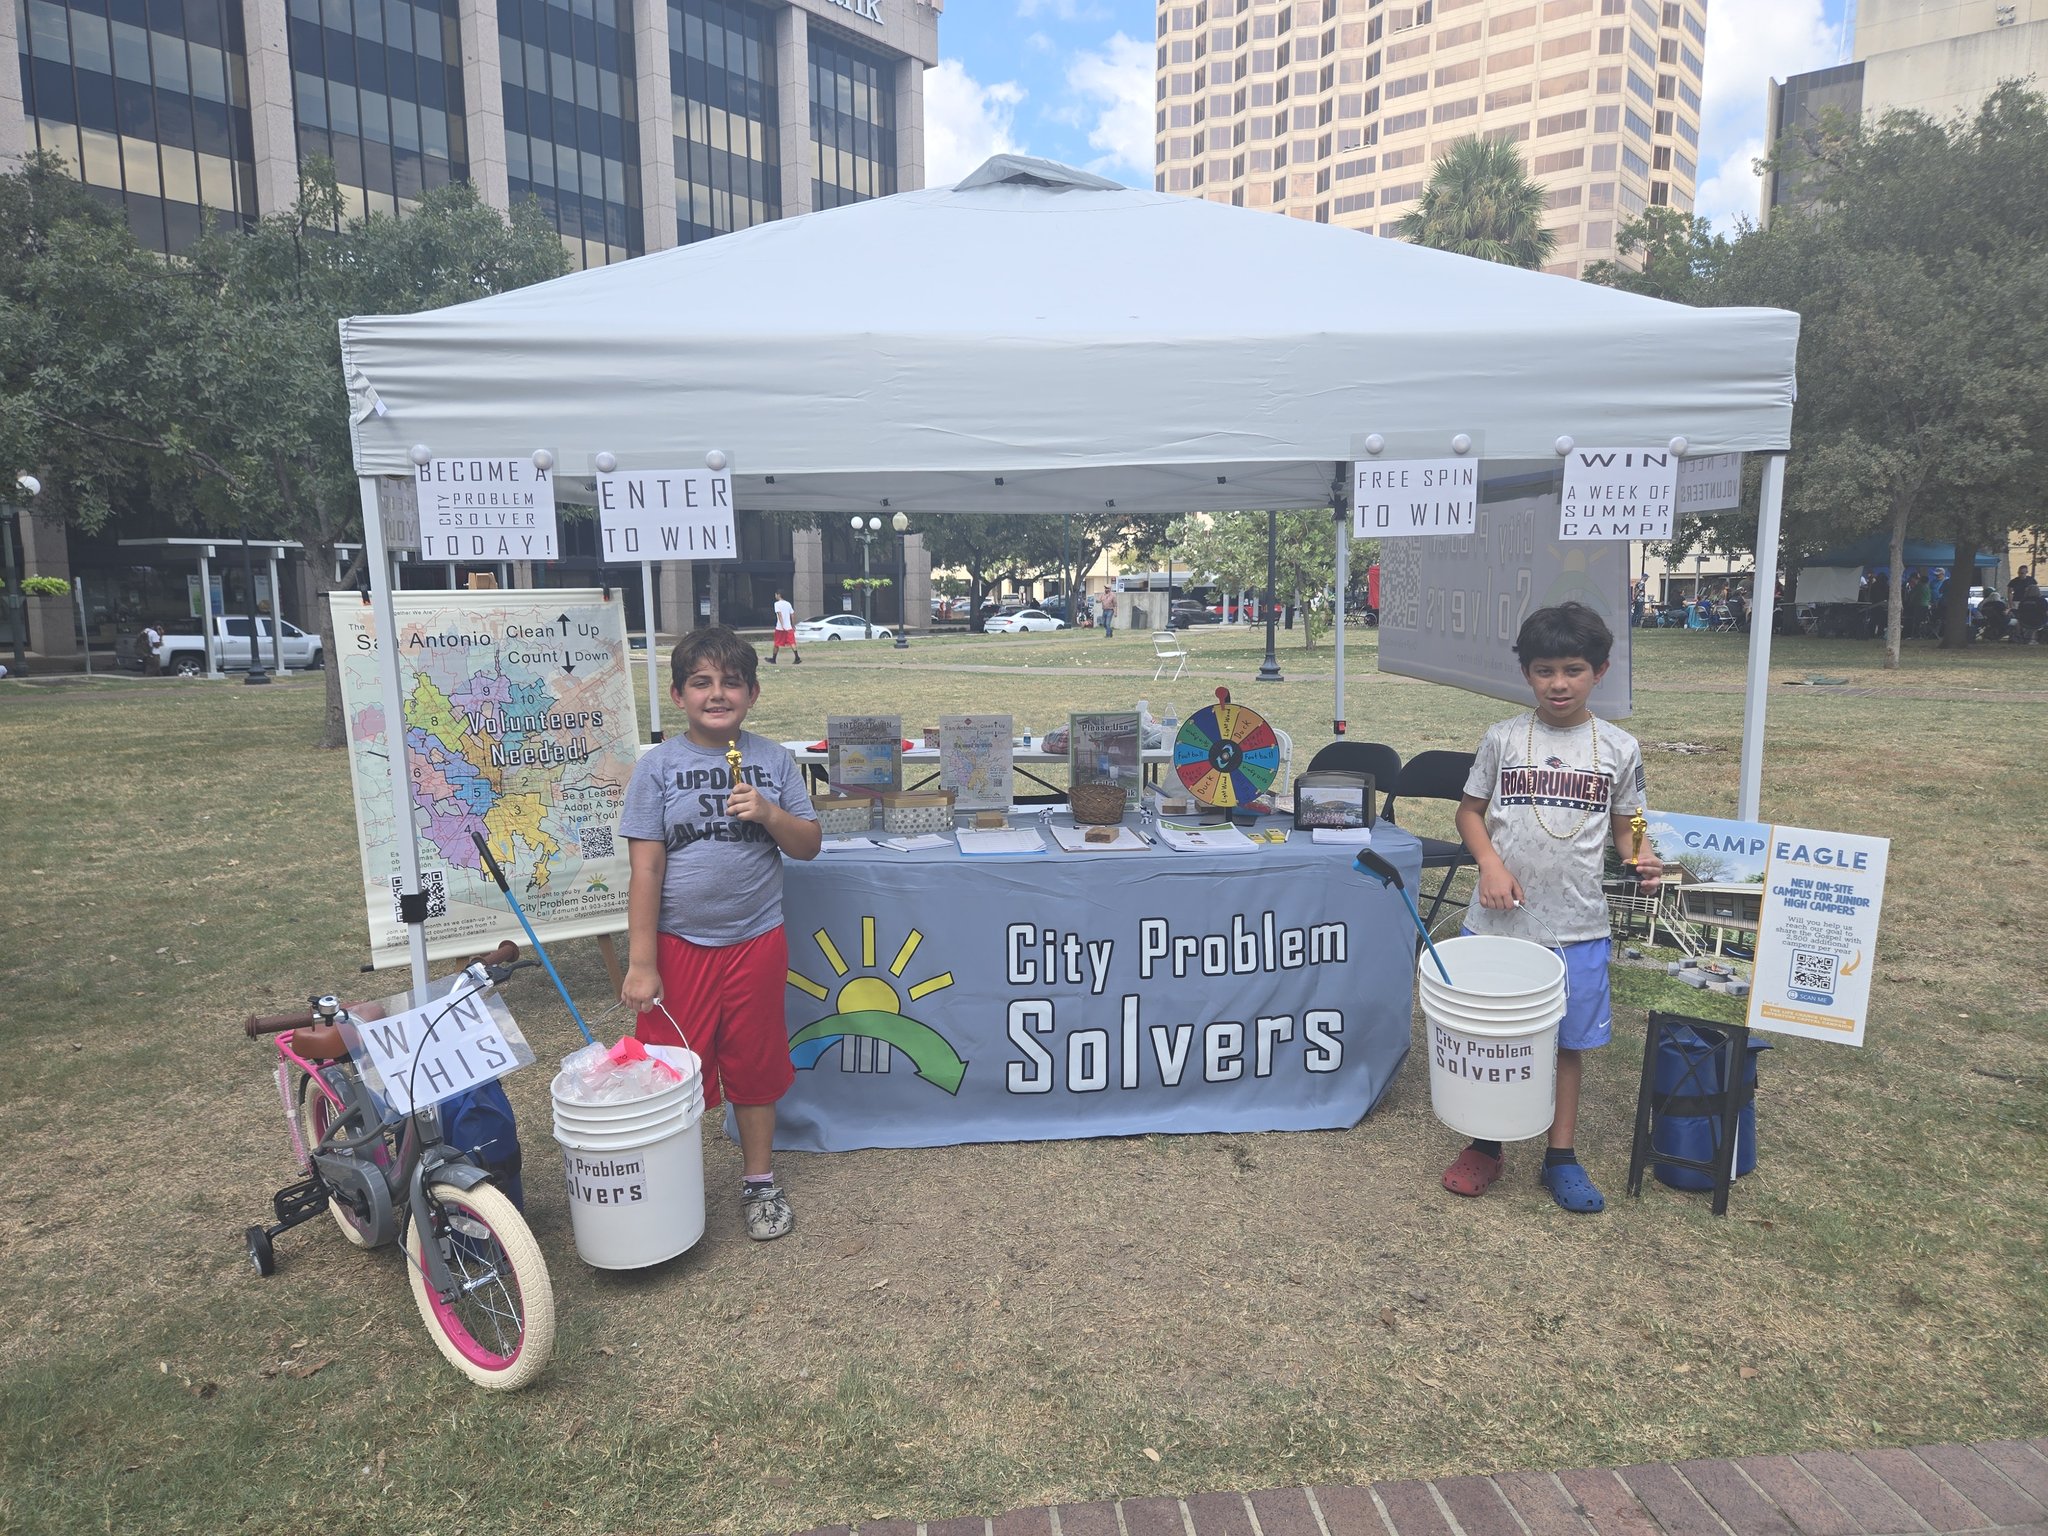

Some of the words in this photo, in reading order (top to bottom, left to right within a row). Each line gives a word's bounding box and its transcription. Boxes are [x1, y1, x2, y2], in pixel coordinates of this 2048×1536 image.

[1579, 453, 1668, 467] WIN
[420, 461, 519, 482] BECOME
[1359, 470, 1409, 488] FREE
[1424, 469, 1472, 486] SPIN
[453, 493, 534, 505] PROBLEM
[602, 478, 727, 509] ENTER
[1567, 486, 1576, 499] A
[1590, 485, 1638, 499] WEEK
[1650, 485, 1670, 499] OF
[438, 494, 450, 526] CITY
[1358, 505, 1389, 528] TO
[1410, 502, 1472, 526] WIN!
[1565, 505, 1669, 517] SUMMER
[455, 513, 534, 525] SOLVER
[1563, 523, 1668, 536] CAMP!
[424, 535, 551, 556] TODAY!
[604, 528, 639, 553] TO
[660, 525, 730, 551] WIN!
[348, 623, 365, 631] The
[507, 625, 554, 639] Clean
[578, 624, 600, 639] Up
[410, 631, 491, 648] Antonio
[508, 650, 558, 664] Count
[575, 651, 609, 661] Down
[483, 687, 490, 696] 9
[521, 695, 535, 704] 10
[431, 716, 439, 726] 8
[467, 710, 603, 735] Volunteers
[1081, 723, 1110, 732] Please
[1112, 723, 1129, 731] Use
[1234, 720, 1251, 739] Duck
[490, 736, 590, 767] Needed!
[413, 768, 421, 777] 6
[522, 777, 528, 786] 2
[1197, 775, 1213, 795] Duck
[1501, 769, 1610, 803] ROADRUNNERS
[474, 788, 480, 797] 5
[514, 805, 521, 816] 3
[564, 803, 592, 813] Adopt
[606, 800, 625, 808] Spo
[568, 814, 592, 824] Near
[595, 811, 618, 821] You!
[464, 825, 471, 834] 4
[1684, 831, 1766, 856] CAMP
[1775, 842, 1869, 871] EAGLE
[1791, 877, 1814, 890] NEW
[1816, 881, 1854, 895] ON-SITE
[528, 891, 552, 900] brought
[561, 889, 572, 897] you
[1773, 886, 1812, 899] CAMPUS
[1813, 890, 1833, 903] FOR
[1835, 893, 1870, 908] JUNIOR
[519, 903, 537, 913] City
[539, 898, 579, 909] Problem
[581, 892, 616, 904] Solvers
[1783, 898, 1808, 910] HIGH
[1809, 901, 1856, 916] CAMPERS
[536, 909, 551, 917] Call
[552, 907, 579, 915] Edmund
[1785, 922, 1807, 930] reach
[1788, 916, 1804, 924] Will
[1823, 921, 1840, 930] help
[1776, 926, 1797, 934] share
[1814, 931, 1842, 941] Gospel
[1782, 940, 1816, 949] campers
[1810, 938, 1849, 948] additional
[1006, 923, 1114, 995] City
[1139, 911, 1349, 980] Problem
[1800, 993, 1816, 1001] SCAN
[369, 995, 484, 1060] WIN
[1006, 994, 1345, 1094] Solvers
[1435, 1026, 1461, 1056] City
[1467, 1040, 1532, 1060] Problem
[390, 1035, 507, 1104] THIS
[1436, 1045, 1531, 1082] Solvers
[576, 1158, 640, 1178] Problem
[568, 1176, 642, 1204] olvers
